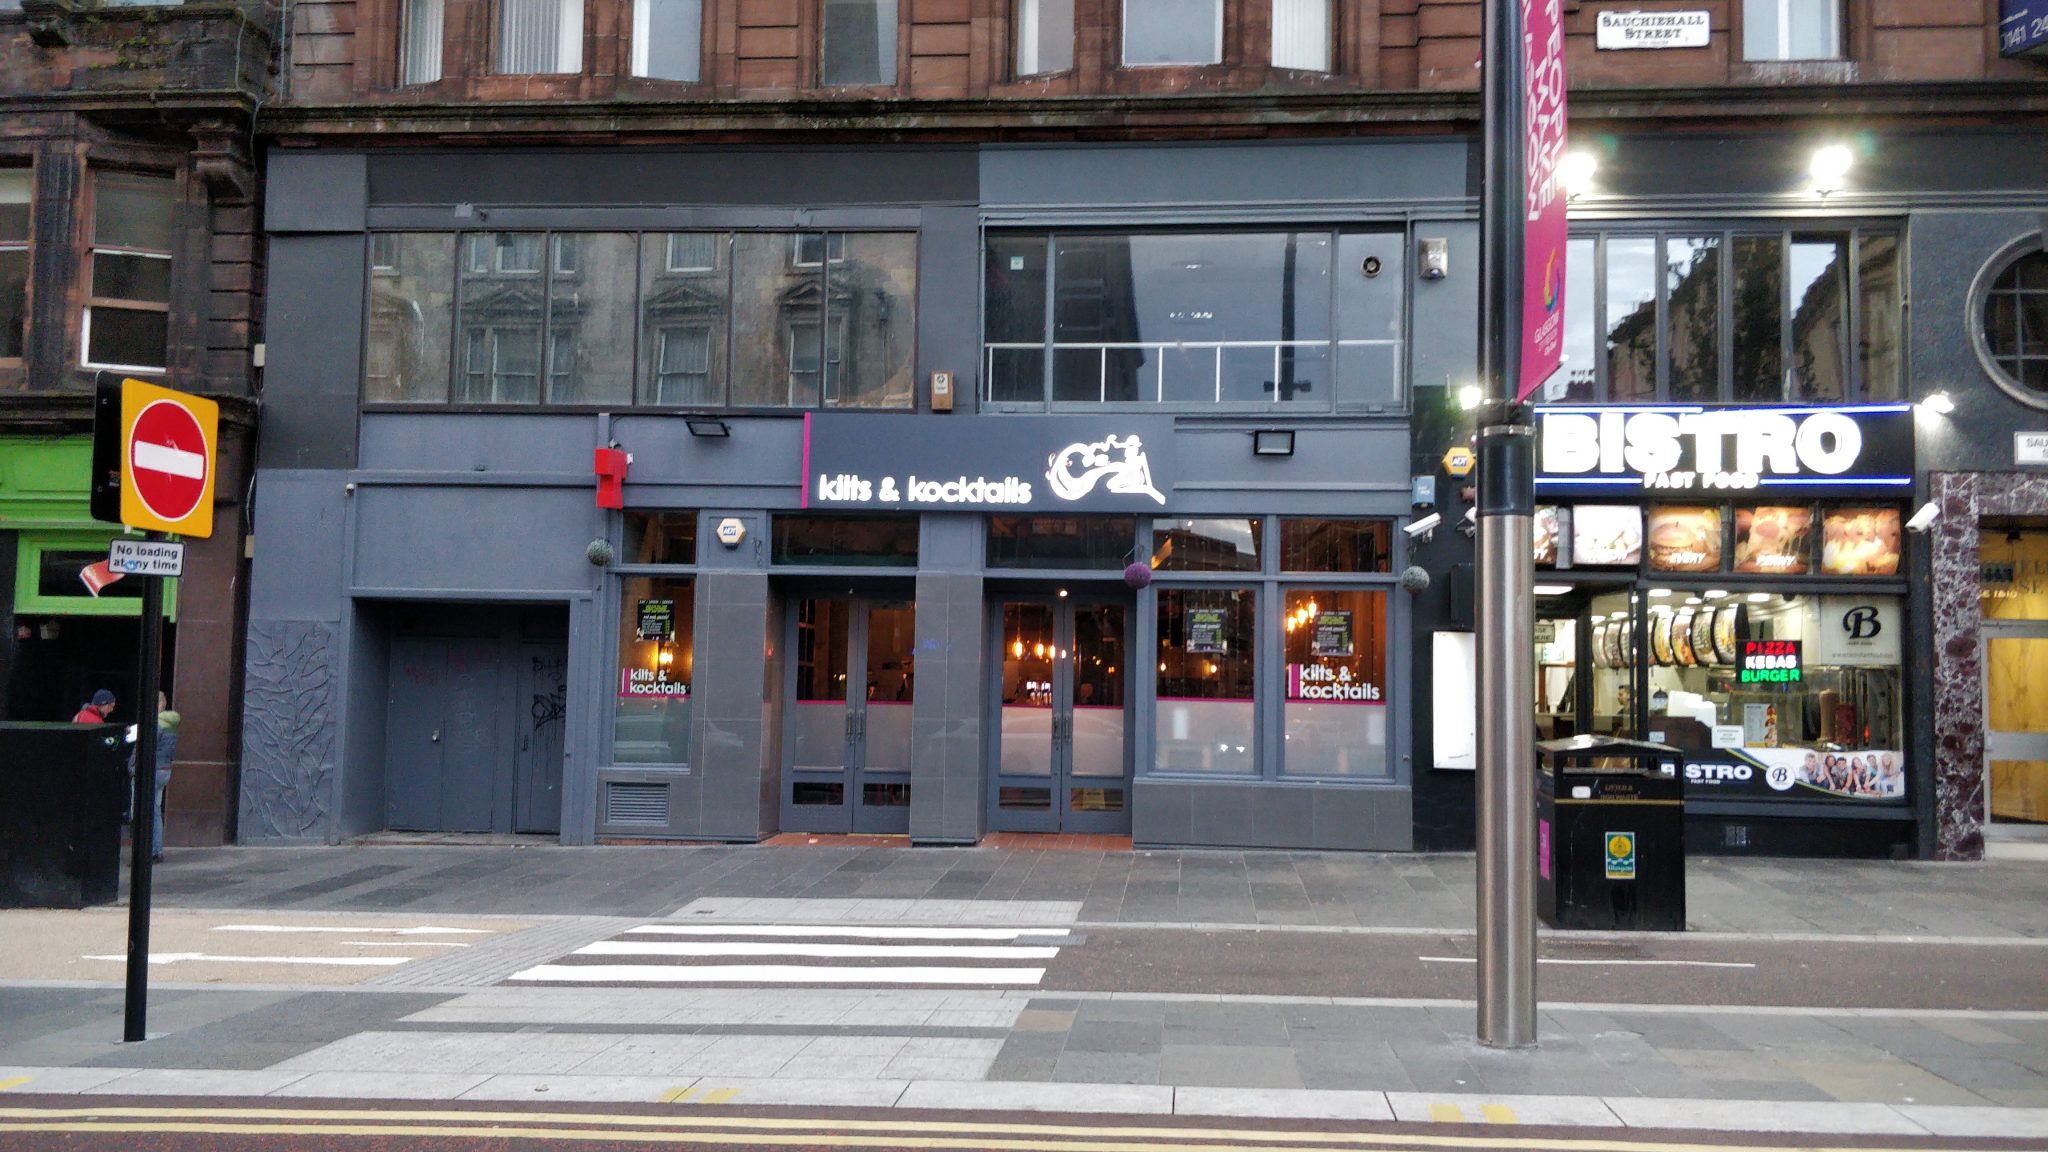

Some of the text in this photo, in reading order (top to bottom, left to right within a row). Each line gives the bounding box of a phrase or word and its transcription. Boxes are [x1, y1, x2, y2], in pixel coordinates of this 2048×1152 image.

[1602, 15, 1704, 28] SAUCHIEHALL
[1625, 28, 1682, 39] STREET
[1523, 0, 1539, 221] LASGOW
[1535, 56, 1551, 216] MAKE
[1543, 412, 1861, 474] BISTRO
[1644, 471, 1759, 489] FAST FOOD
[819, 474, 1032, 504] kilts & kocktails
[116, 545, 178, 559] No loading
[113, 558, 124, 567] at
[153, 561, 178, 570] time
[1843, 606, 1881, 639] B
[1746, 641, 1796, 655] PIZZA
[630, 668, 667, 682] kilts &
[1300, 664, 1351, 681] kilts &
[1741, 669, 1800, 682] BURGER
[630, 682, 686, 694] kocktails
[1300, 683, 1380, 700] kocktails
